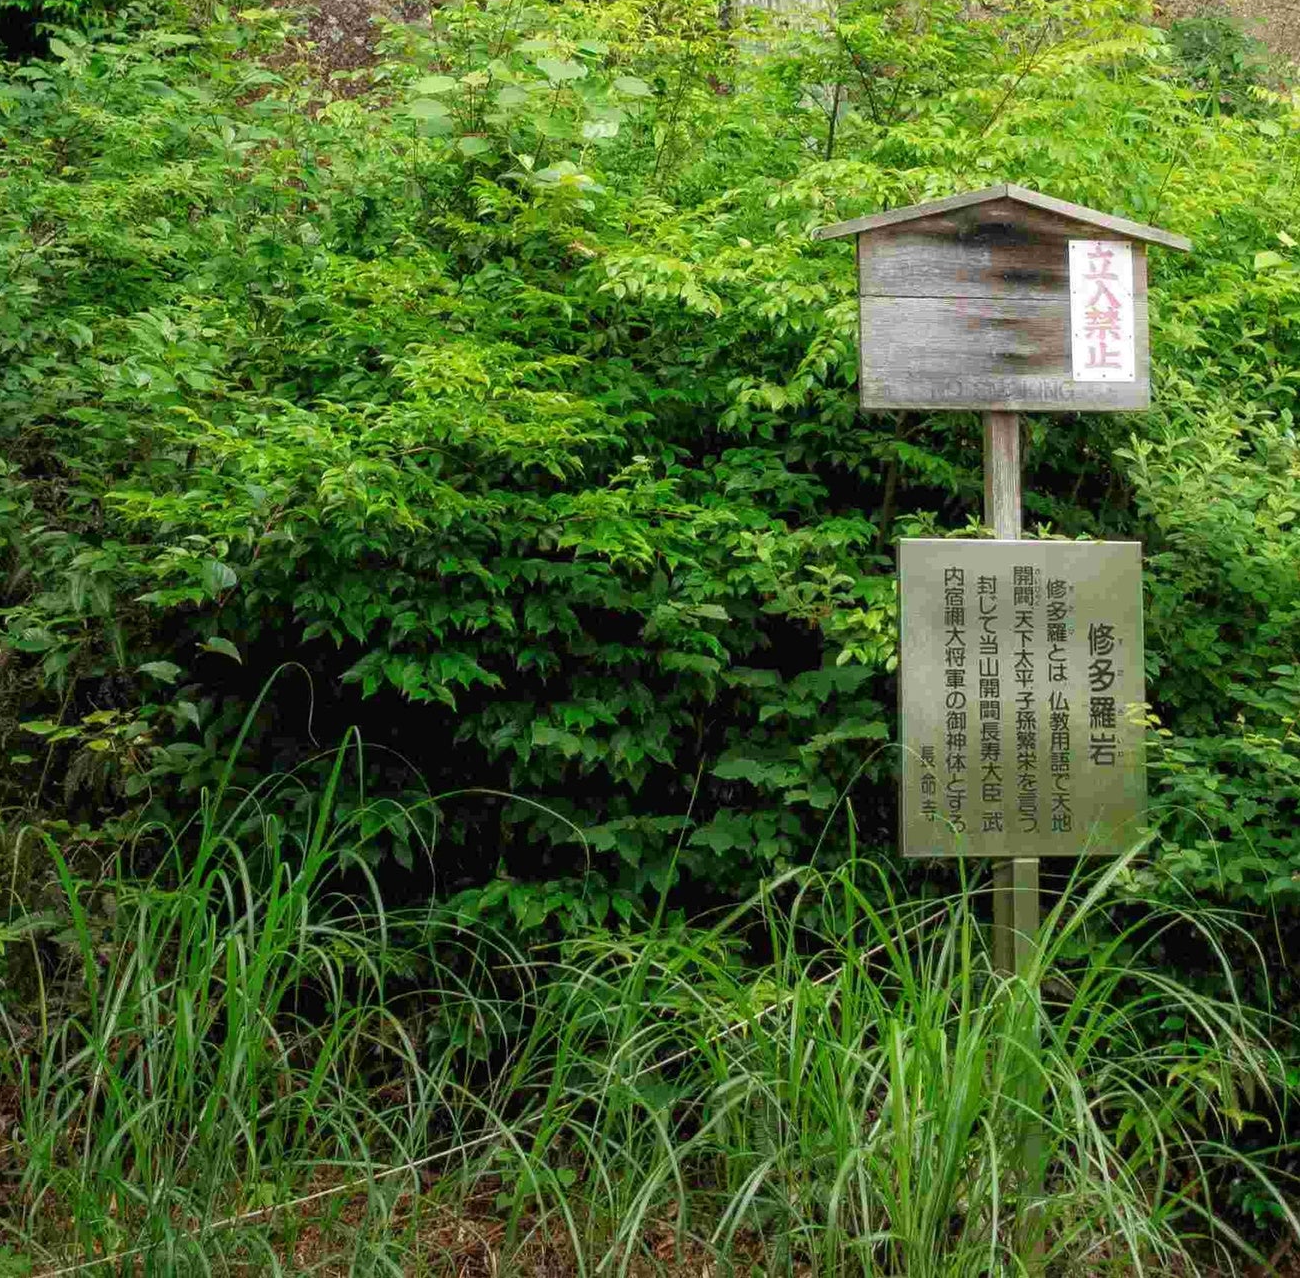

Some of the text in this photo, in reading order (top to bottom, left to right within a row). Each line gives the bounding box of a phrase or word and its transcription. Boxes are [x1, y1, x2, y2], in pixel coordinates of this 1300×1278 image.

[1084, 245, 1122, 369] 立入禁止
[1088, 622, 1116, 767] 修多羅岩
[921, 745, 937, 822] 長命寺
